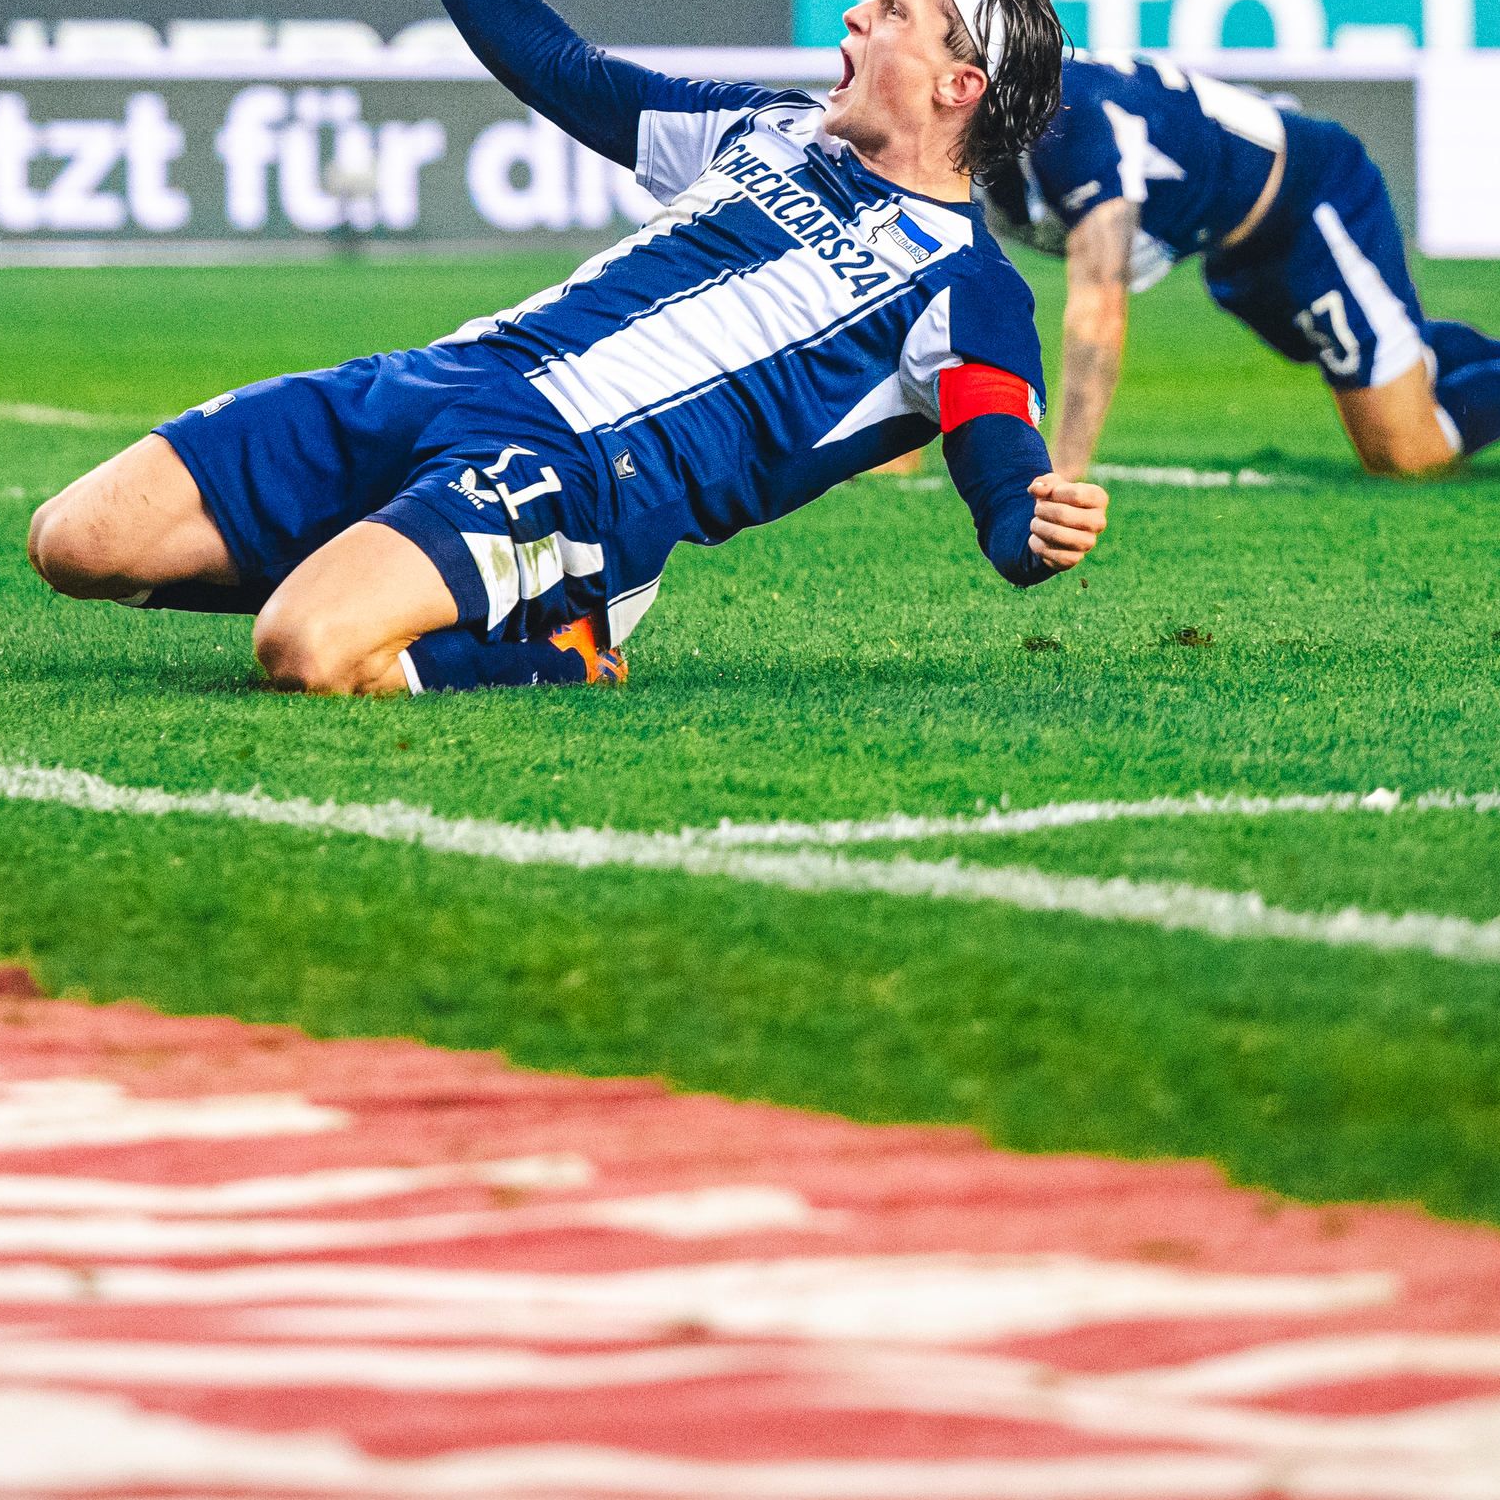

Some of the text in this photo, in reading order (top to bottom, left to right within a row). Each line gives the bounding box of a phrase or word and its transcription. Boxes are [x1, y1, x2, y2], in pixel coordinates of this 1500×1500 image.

[215, 83, 446, 235] für
[710, 144, 891, 299] CHECKCARS24
[887, 224, 928, 261] Hertha BSC
